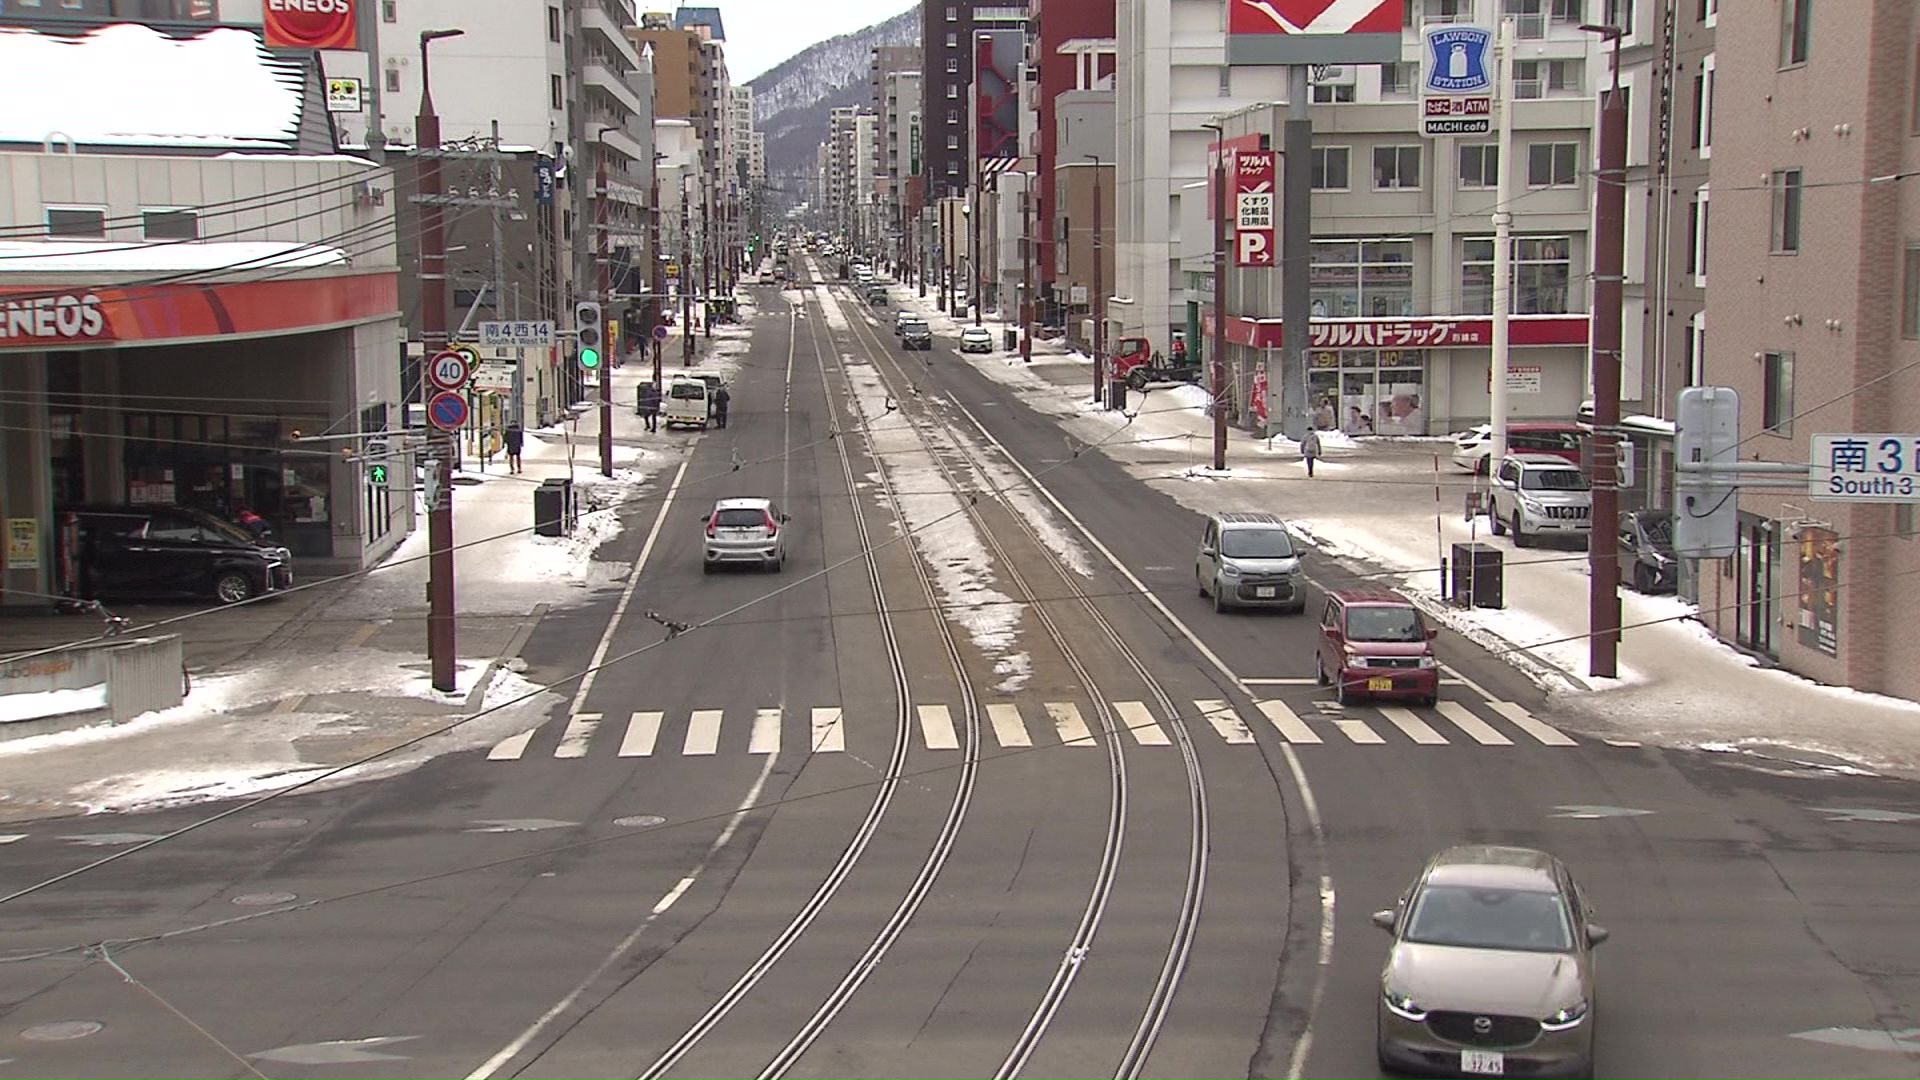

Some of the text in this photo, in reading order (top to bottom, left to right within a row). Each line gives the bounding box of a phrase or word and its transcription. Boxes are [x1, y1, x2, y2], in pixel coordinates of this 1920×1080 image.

[269, 0, 349, 13] ENEOS
[1434, 32, 1484, 44] LAWSON
[1433, 75, 1483, 88] STATION
[1466, 100, 1488, 112] ATM
[1240, 156, 1271, 167] ツルハ
[1242, 197, 1269, 206] くすり
[1241, 207, 1269, 216] 化粧品
[1241, 217, 1269, 226] 日用品
[1240, 233, 1266, 263] P
[1309, 323, 1456, 346] ツルハドラッグ
[439, 362, 460, 379] 40
[1830, 438, 1920, 473] 南3
[1830, 476, 1913, 495] South 3
